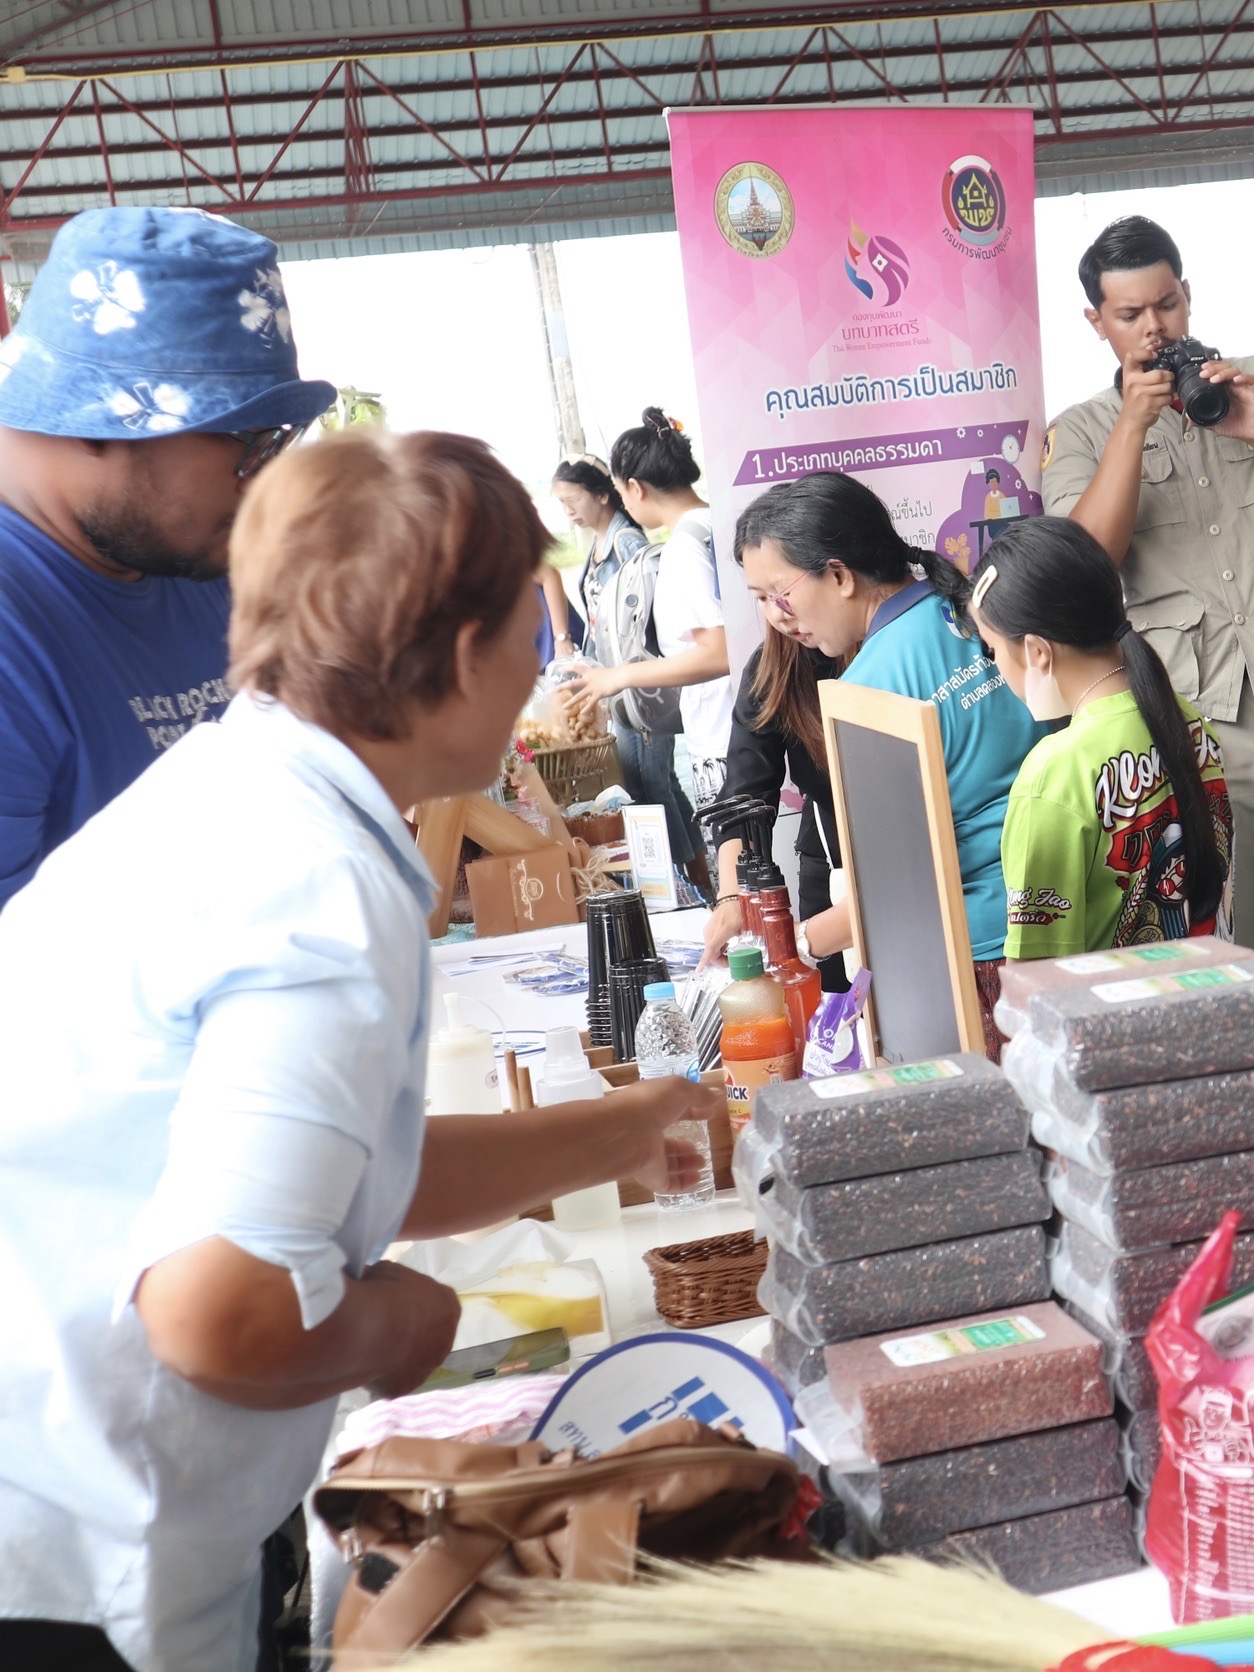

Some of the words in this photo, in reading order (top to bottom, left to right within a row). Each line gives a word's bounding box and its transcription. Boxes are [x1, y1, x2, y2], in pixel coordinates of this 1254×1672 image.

[841, 318, 920, 341] บทบาทสตรี
[846, 342, 867, 352] Women
[867, 339, 912, 351] Empowerment
[912, 336, 932, 346] Funds
[765, 362, 1018, 419] คุณสมบัติการเป็นสมาชิก
